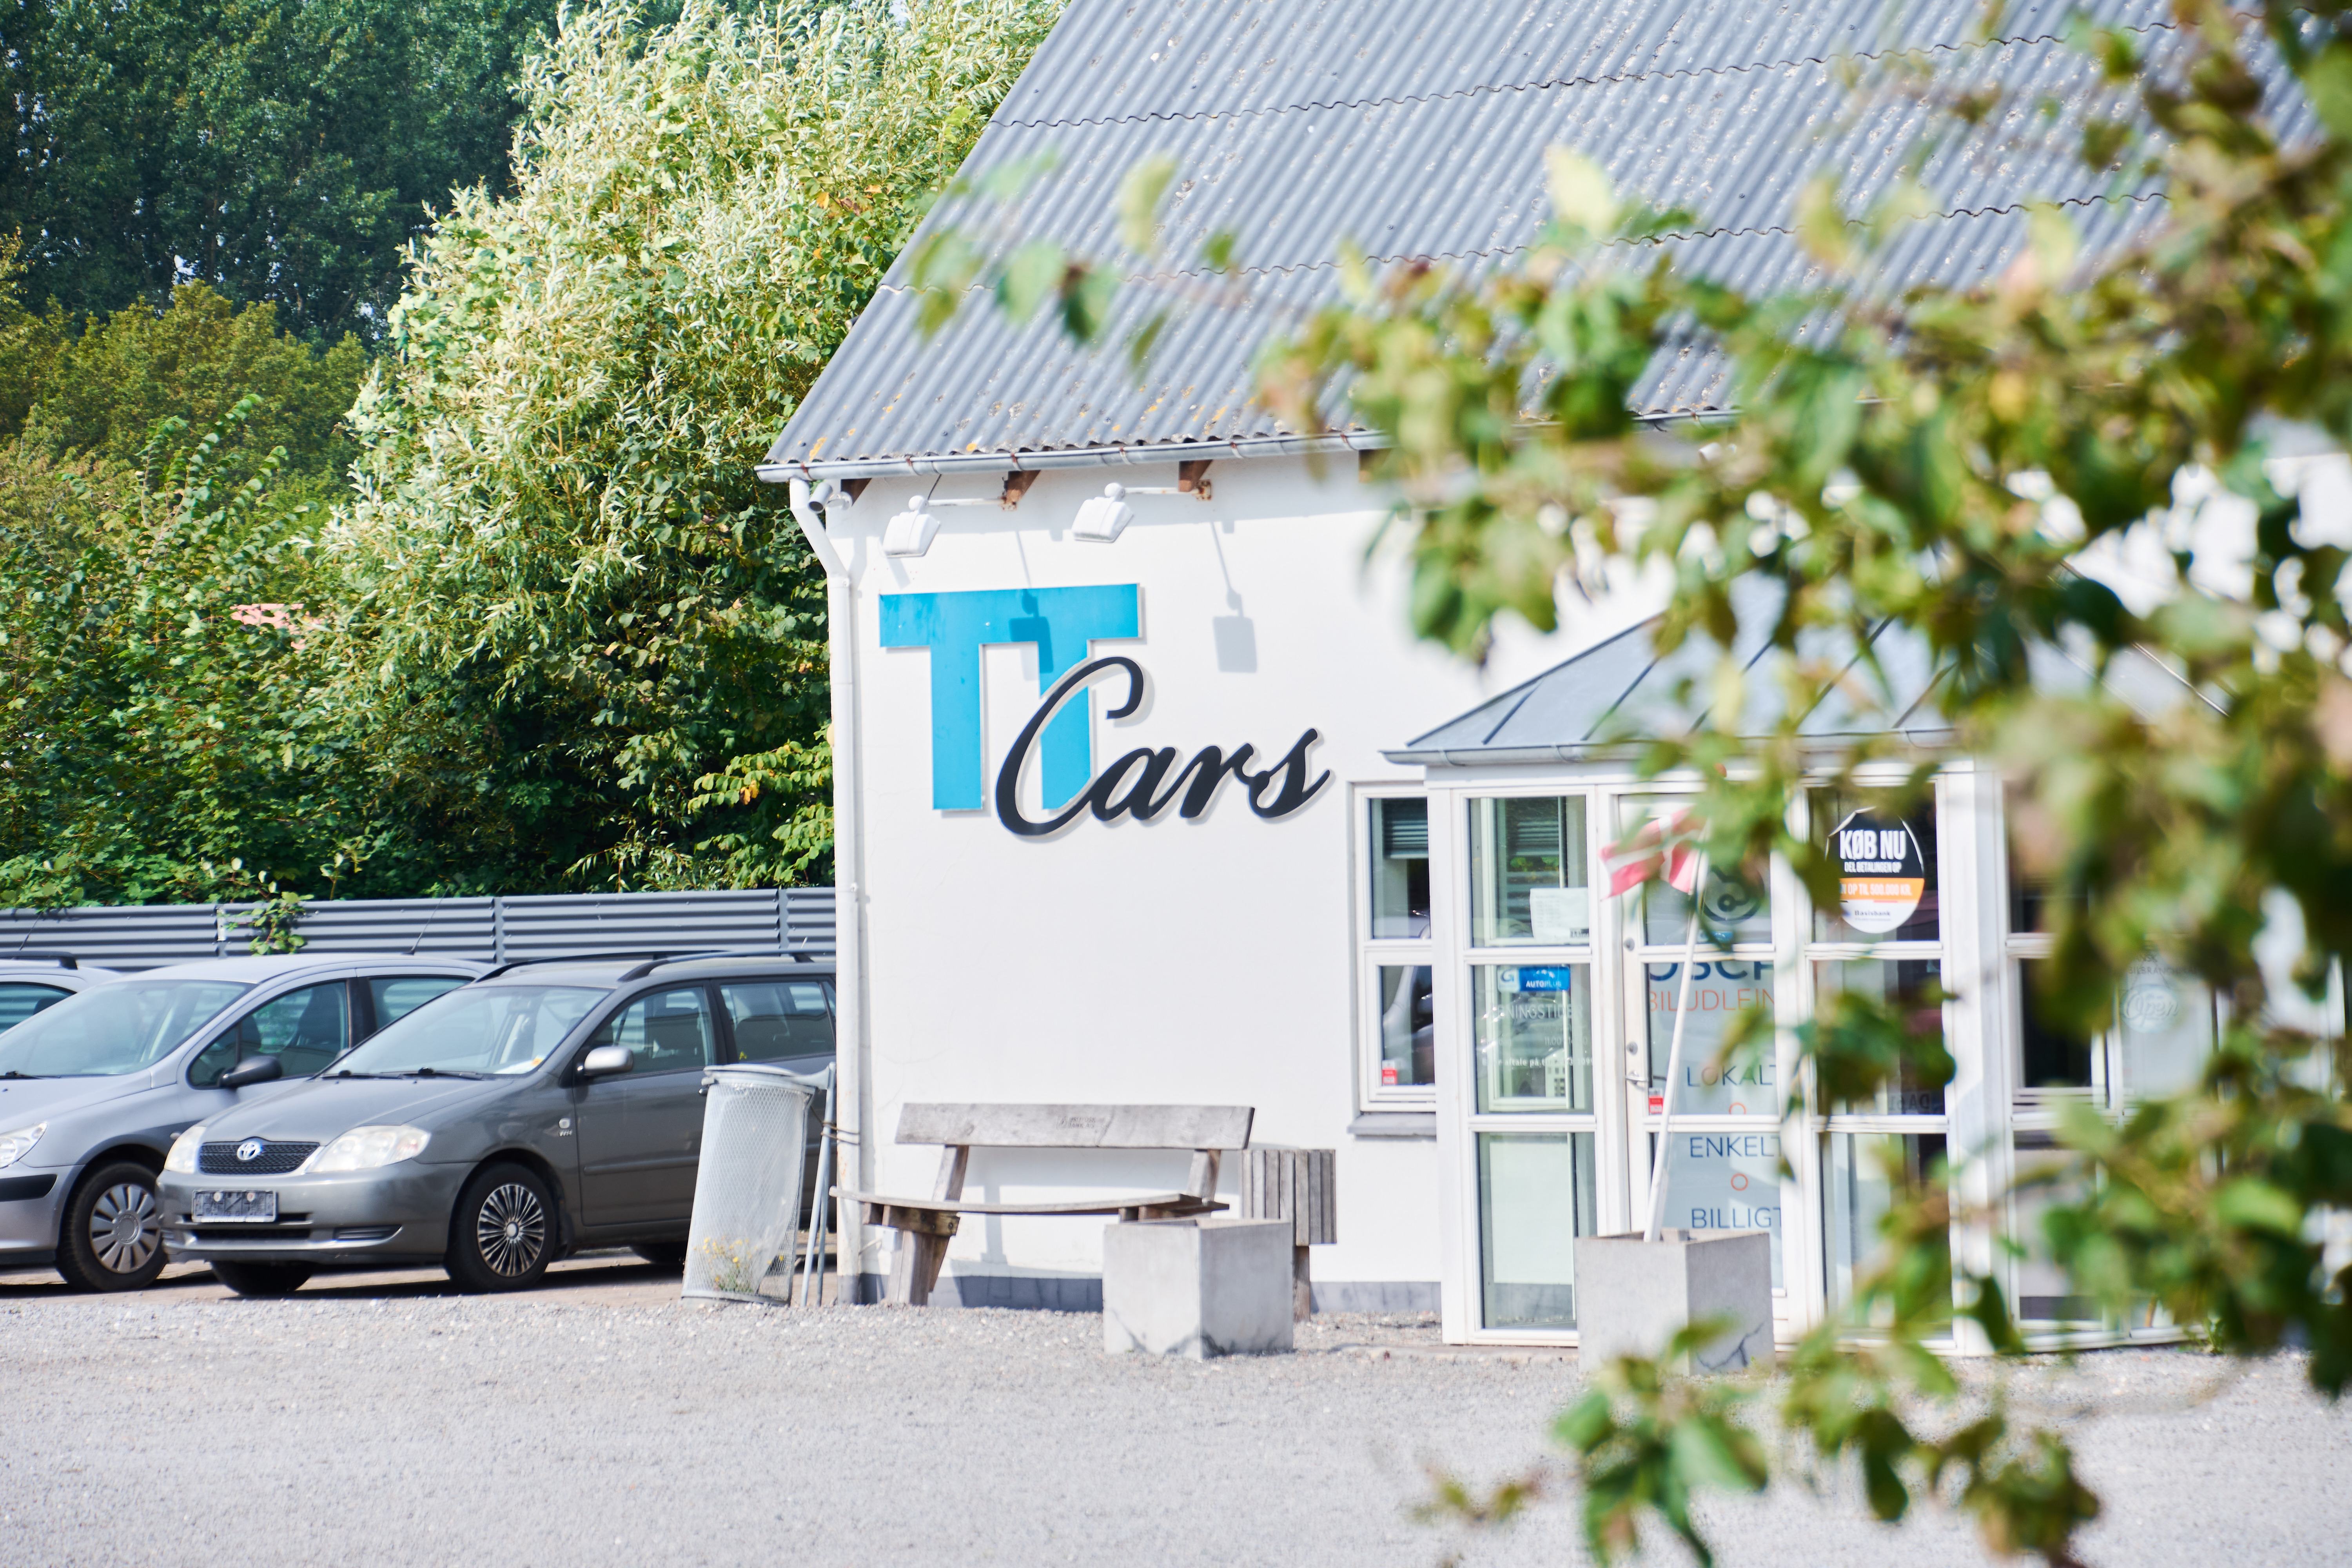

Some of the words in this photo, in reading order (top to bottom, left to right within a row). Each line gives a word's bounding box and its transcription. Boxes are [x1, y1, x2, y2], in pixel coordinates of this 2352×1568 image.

[879, 583, 1140, 810] TT
[996, 657, 1331, 836] Cars
[1840, 829, 1878, 860] KØB
[1880, 830, 1906, 860] NU
[1856, 861, 1893, 873] BETALINGEN
[1892, 861, 1902, 873] OP
[1847, 883, 1858, 895] OP
[1859, 883, 1869, 896] TIL
[1870, 884, 1900, 896] 500.000
